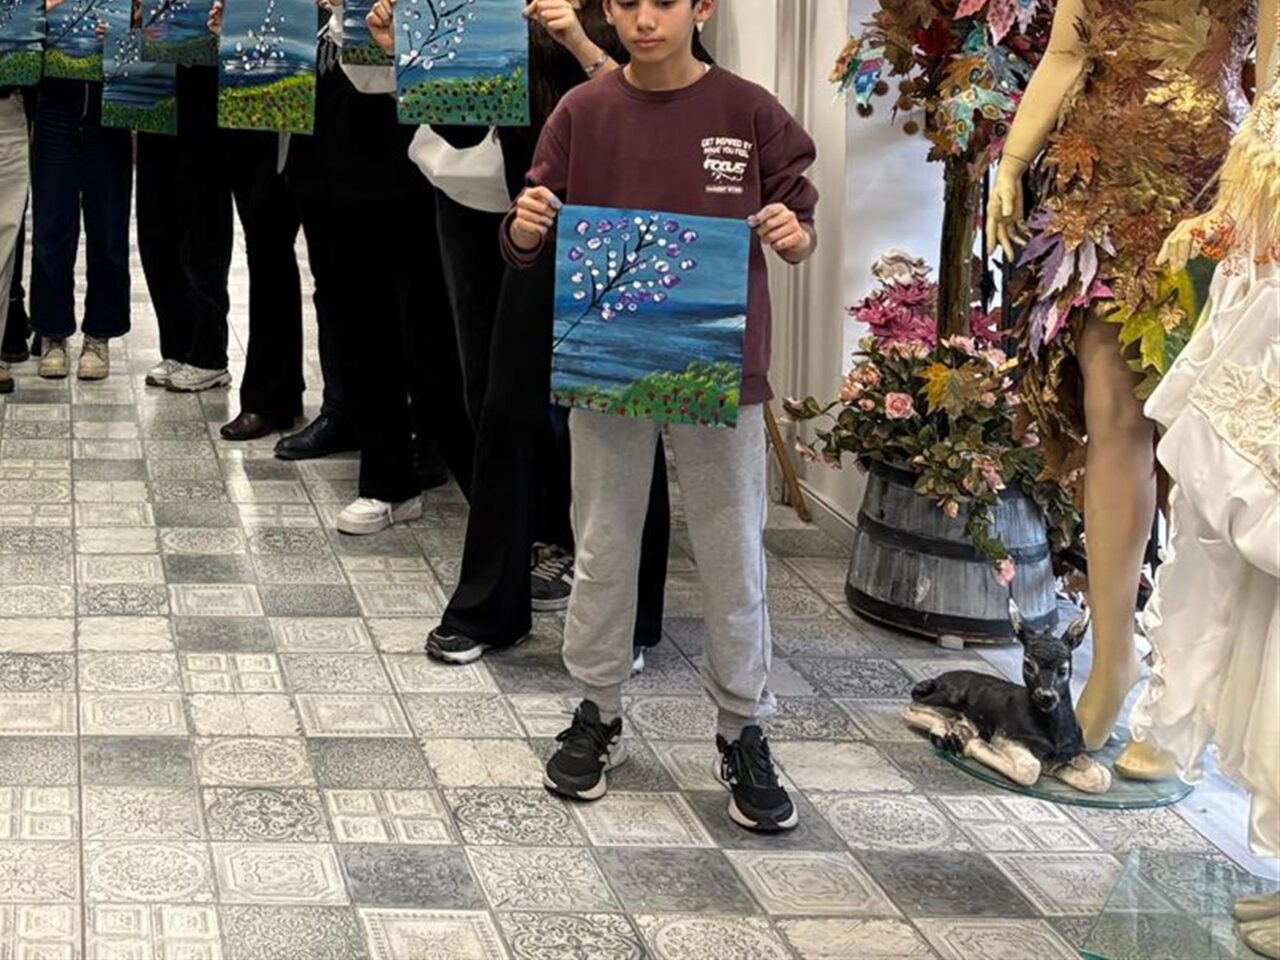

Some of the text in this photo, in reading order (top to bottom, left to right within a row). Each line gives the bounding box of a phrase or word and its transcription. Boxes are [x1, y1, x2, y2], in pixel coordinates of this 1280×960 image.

[701, 138, 714, 148] GET
[743, 140, 753, 151] BY
[722, 146, 735, 154] YOU
[703, 159, 747, 174] FOCUS
